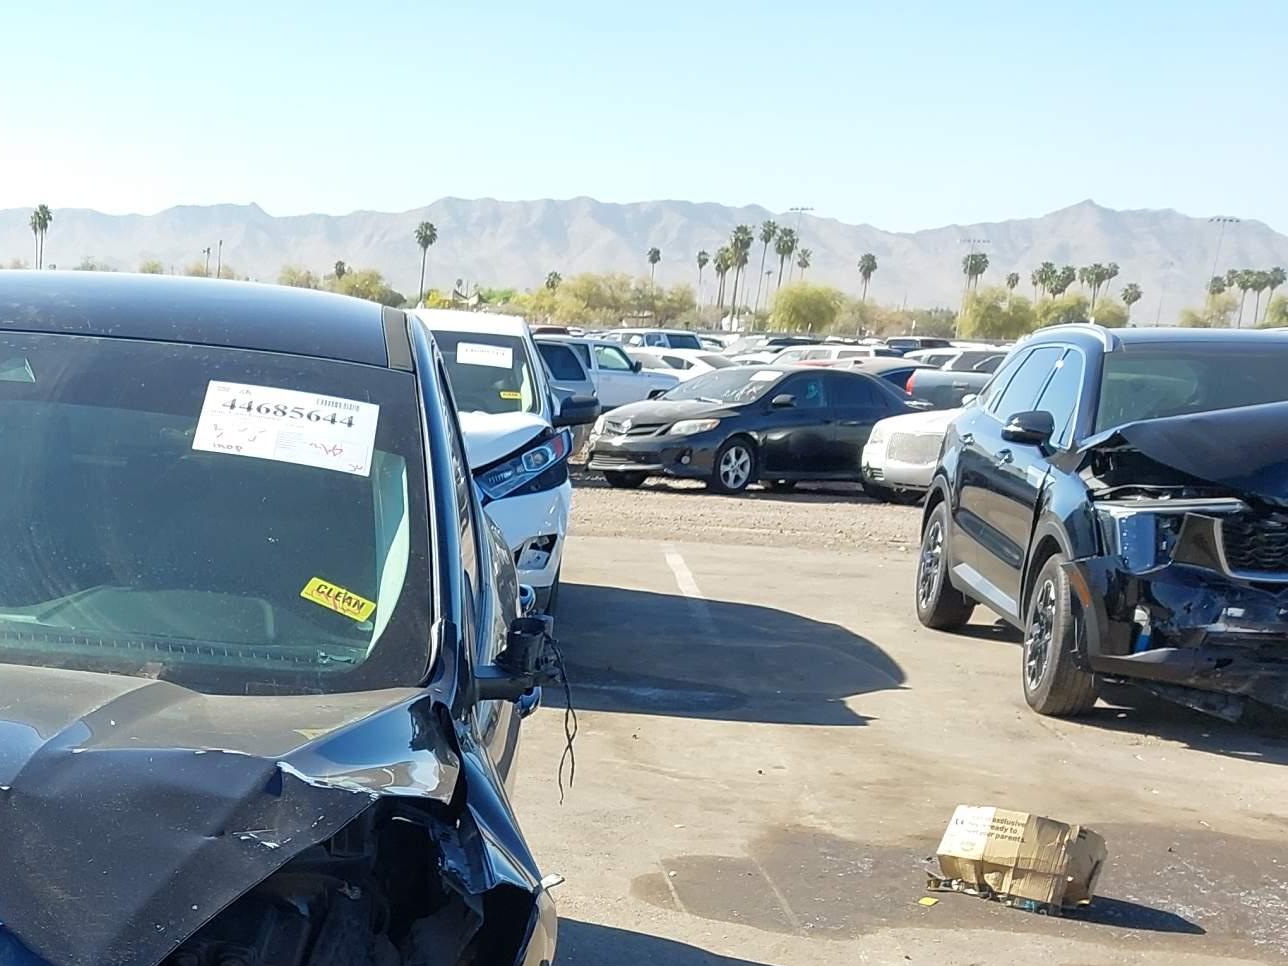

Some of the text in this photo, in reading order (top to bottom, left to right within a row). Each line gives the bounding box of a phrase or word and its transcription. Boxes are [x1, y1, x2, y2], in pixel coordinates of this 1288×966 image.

[222, 398, 355, 428] 44685644
[316, 584, 365, 610] CLEAN
[1009, 826, 1018, 834] to
